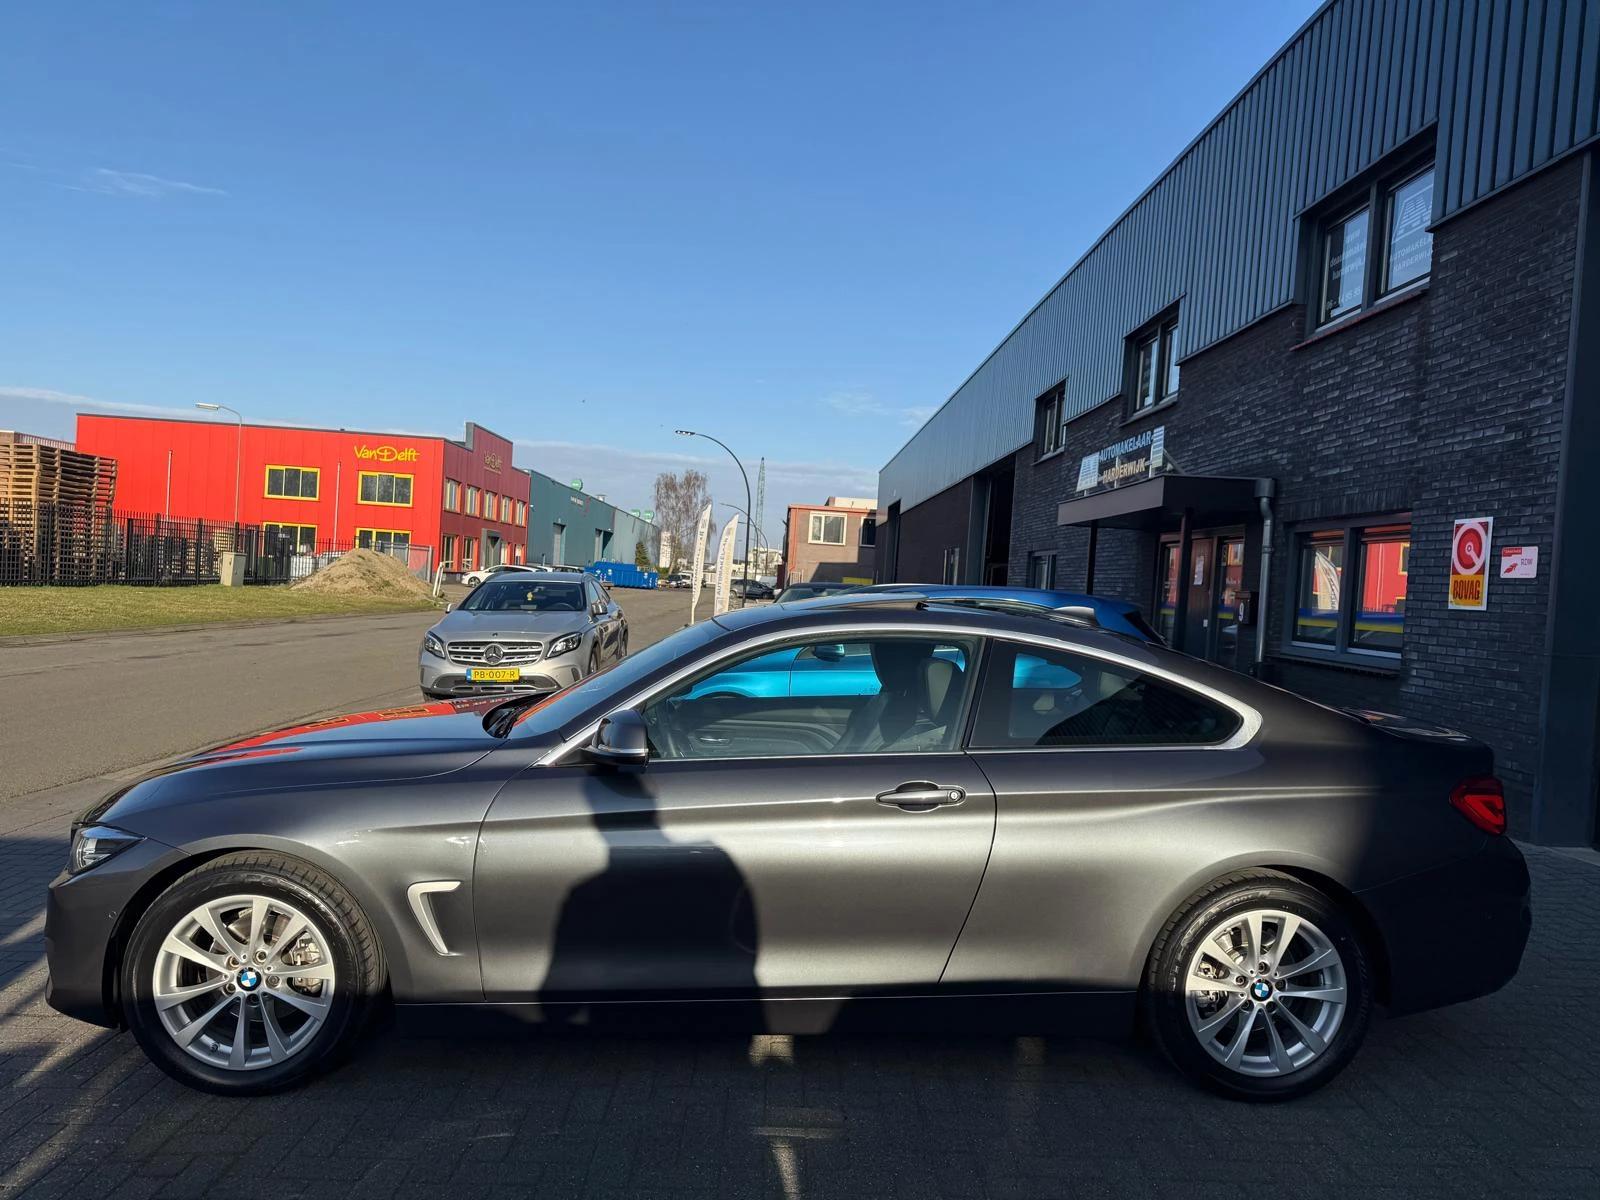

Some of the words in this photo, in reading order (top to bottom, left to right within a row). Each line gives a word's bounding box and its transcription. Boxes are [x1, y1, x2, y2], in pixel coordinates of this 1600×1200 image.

[1100, 430, 1152, 462] AUTOMAKELAAR
[1103, 457, 1147, 484] HARDERWIJK
[1453, 579, 1481, 600] BOVAG
